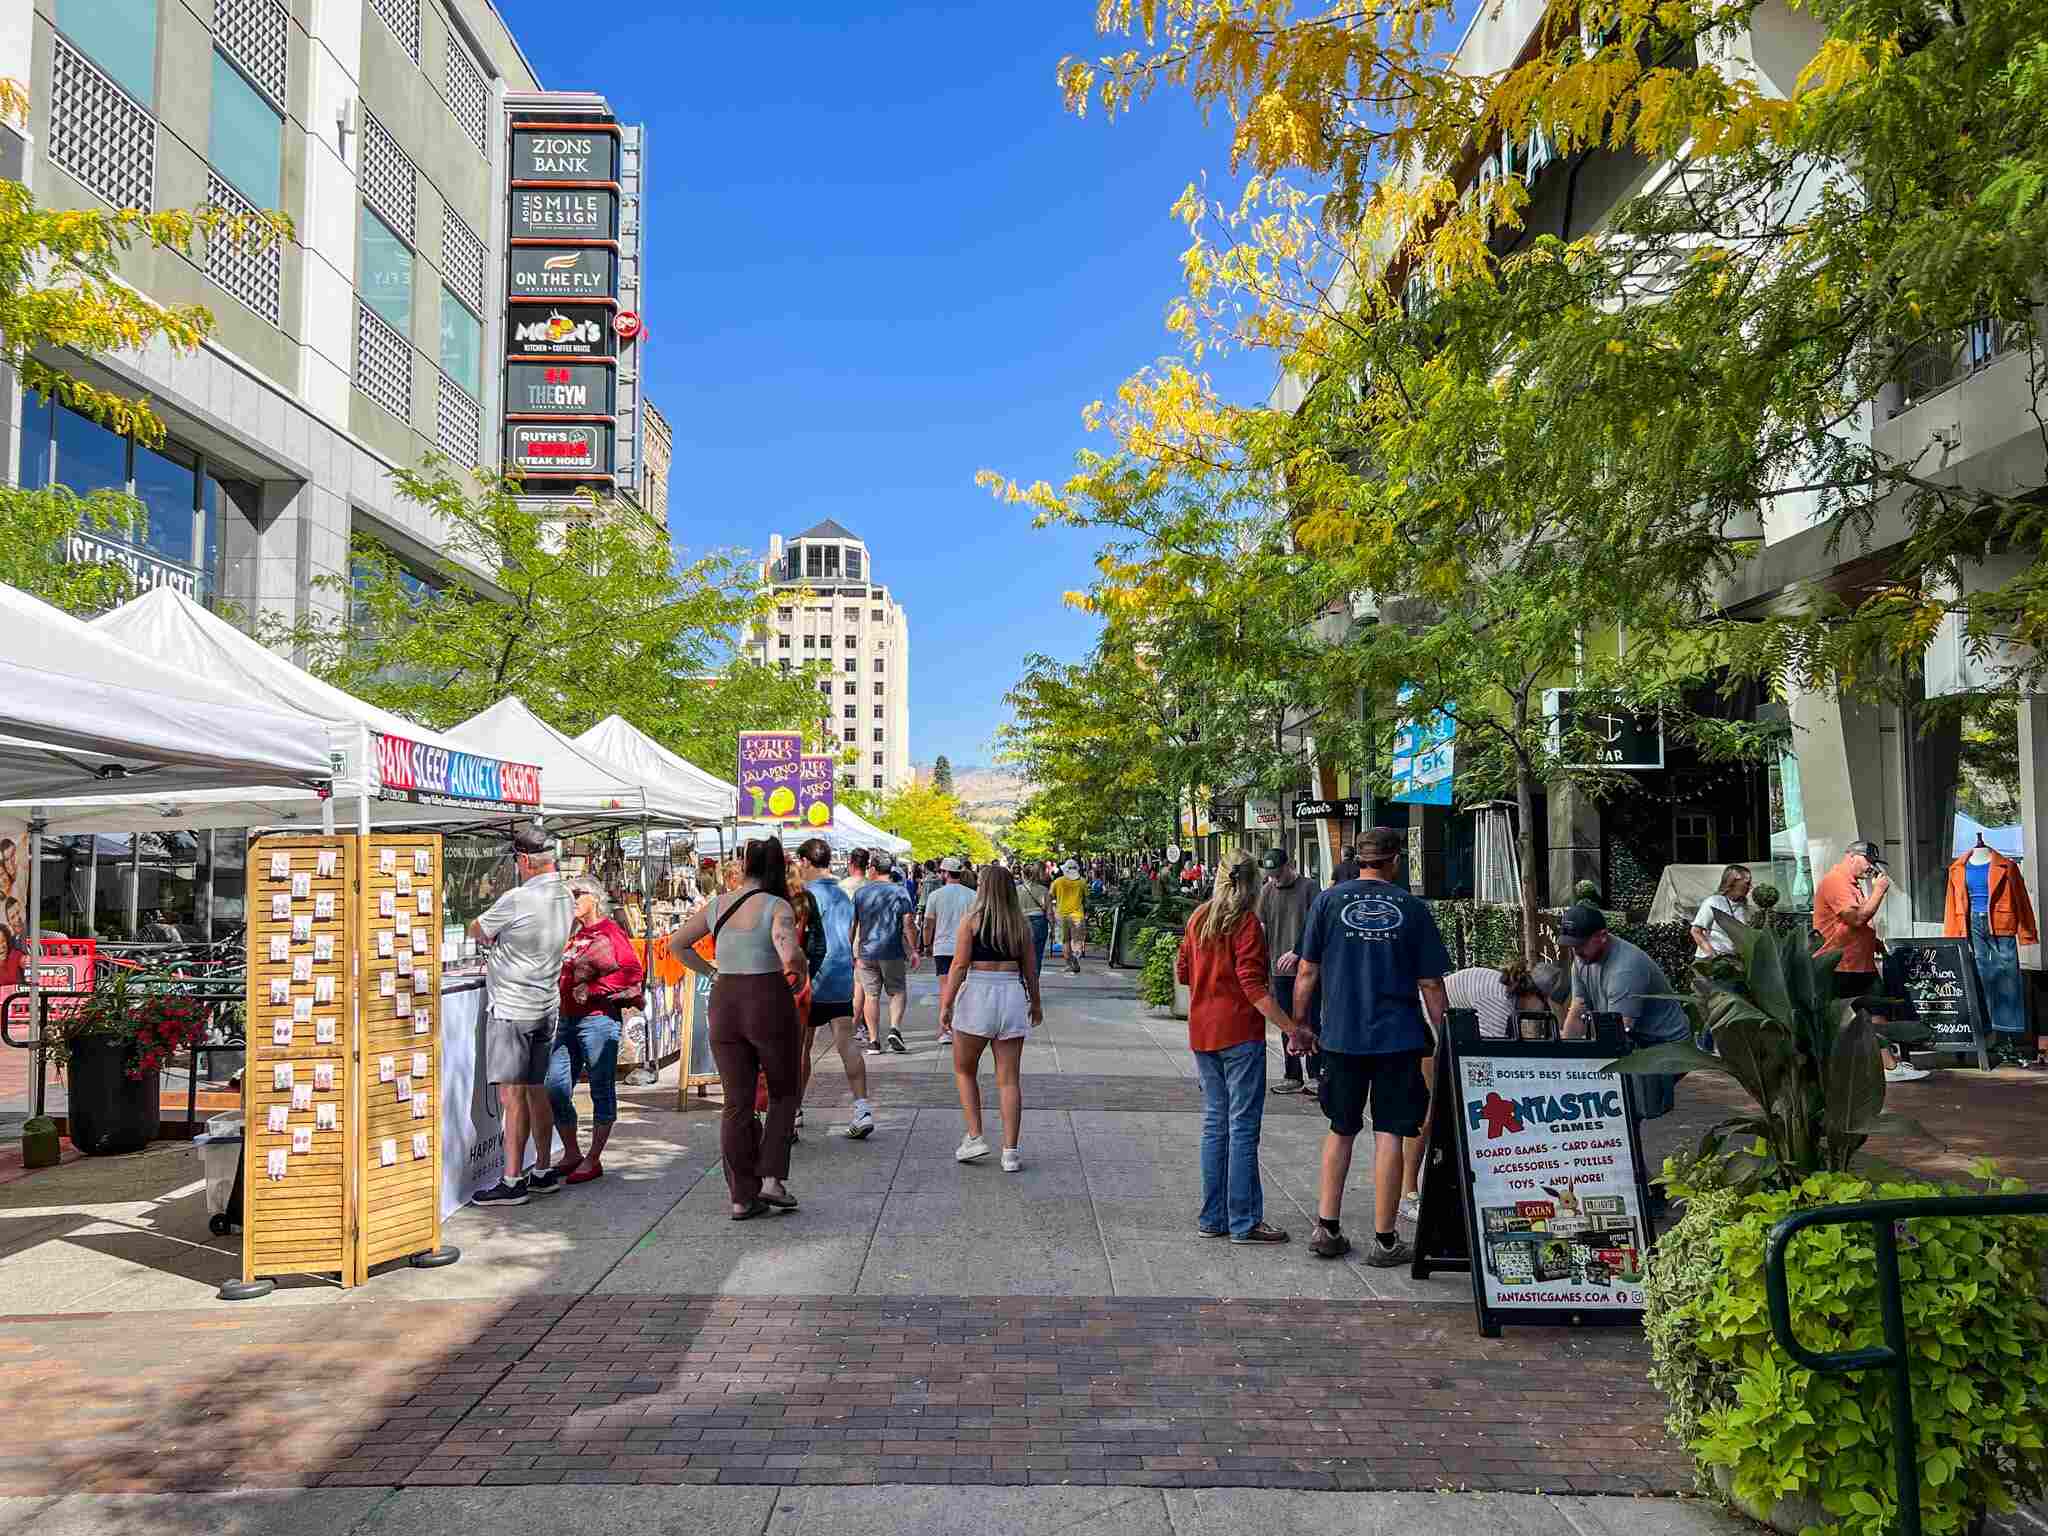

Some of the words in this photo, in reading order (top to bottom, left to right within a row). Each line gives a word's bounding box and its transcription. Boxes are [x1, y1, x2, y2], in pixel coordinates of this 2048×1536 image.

[532, 139, 591, 154] ZIONS
[534, 158, 589, 172] BANK
[533, 196, 598, 210] SMILE
[532, 211, 598, 223] DESIGN
[516, 273, 537, 286] ON
[541, 273, 569, 286] THE
[573, 273, 600, 286] FLY
[520, 431, 567, 442] RUTH'S
[517, 456, 552, 466] STEAK
[556, 457, 592, 466] HOUSE
[1421, 750, 1447, 772] 5K
[413, 743, 449, 793] SLEEP
[451, 752, 498, 799] ANXIETY
[500, 761, 541, 802] ENERGY
[1496, 1070, 1535, 1080] BOISE'S
[1539, 1071, 1561, 1080] BEST
[1549, 1120, 1604, 1134] GAMES
[1476, 1146, 1511, 1159] BOARD
[1515, 1144, 1548, 1156] GAMES
[1561, 1140, 1588, 1152] CARD
[1590, 1138, 1623, 1150] GAMES
[1493, 1159, 1560, 1175] ACCESSORIES
[1574, 1155, 1614, 1168] PUZZLES
[1509, 1179, 1535, 1190] TOYS
[1550, 1175, 1568, 1186] AND
[1573, 1173, 1605, 1185] MORE!
[1525, 1206, 1552, 1218] CATAN
[1496, 1291, 1610, 1303] FANTASTICGAMES.COM
